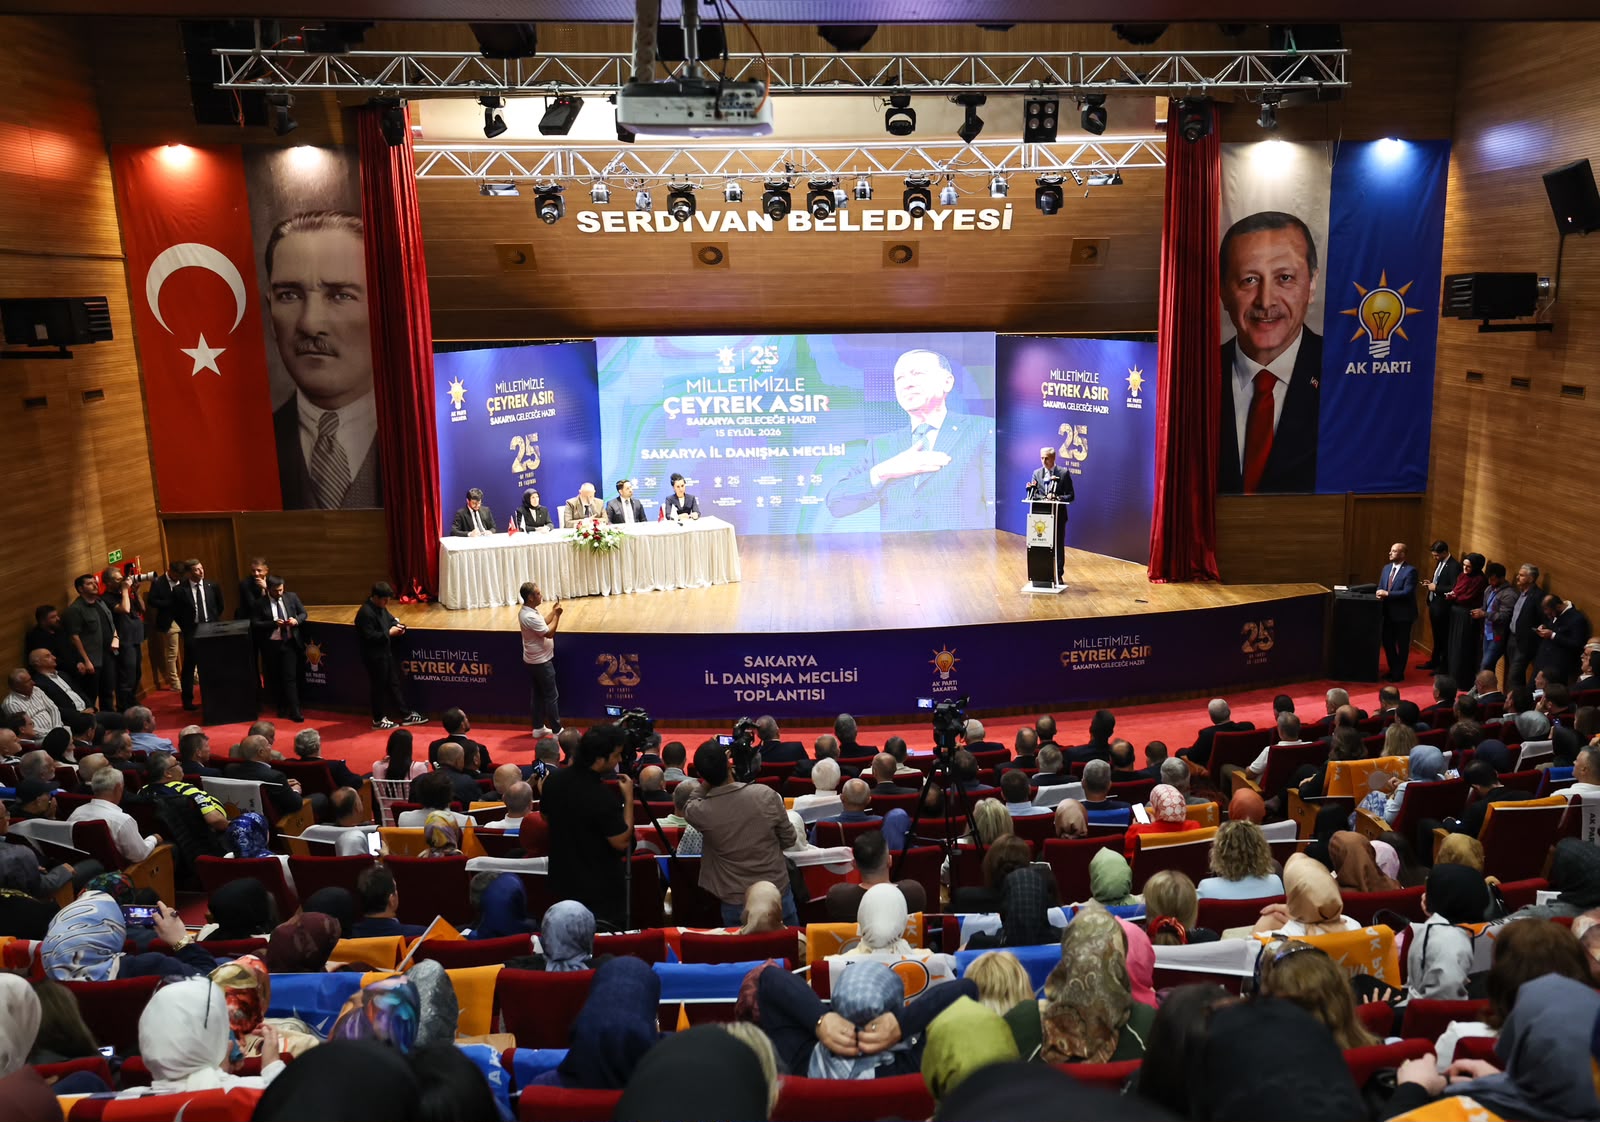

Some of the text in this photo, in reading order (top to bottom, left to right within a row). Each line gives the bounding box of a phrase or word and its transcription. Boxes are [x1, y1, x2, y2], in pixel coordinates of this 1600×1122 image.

[750, 345, 779, 366] 25
[1050, 368, 1100, 384] MİLLETİMİZLE
[1345, 362, 1368, 374] AK
[495, 377, 545, 394] MİLLETİMİZLE
[686, 376, 805, 394] MİLLETİMİZLE
[1041, 382, 1109, 401] ÇEYREK ASIR
[486, 390, 555, 416] ÇEYREK ASIR
[663, 394, 831, 420] ÇEYREK ASIR
[1043, 400, 1067, 410] SAKARYA
[1093, 404, 1109, 414] HAZIR
[490, 414, 516, 426] SAKARYA
[541, 408, 556, 417] HAZIR
[686, 414, 817, 427] SAKARYA GELECEĞE HAZIR
[715, 427, 782, 437] 15 EYLÜL 2026
[1058, 423, 1089, 461] 25
[510, 432, 541, 474] 25
[640, 443, 846, 461] SAKARYA İL DANIŞMA MECLİSİ
[1073, 635, 1141, 649] MİLLETİMİZLE
[1240, 618, 1274, 653] 25
[412, 648, 479, 661] MİLLETİMİZLE
[743, 655, 818, 668] SAKARYA
[1060, 648, 1117, 668] ÇEYREK
[460, 662, 494, 675] ASIR
[595, 653, 641, 687] 25
[1072, 663, 1100, 671] SAKARYA
[704, 667, 858, 688] İL DANIŞMA MECLİSİ
[734, 689, 825, 702] TOPLANTISI
